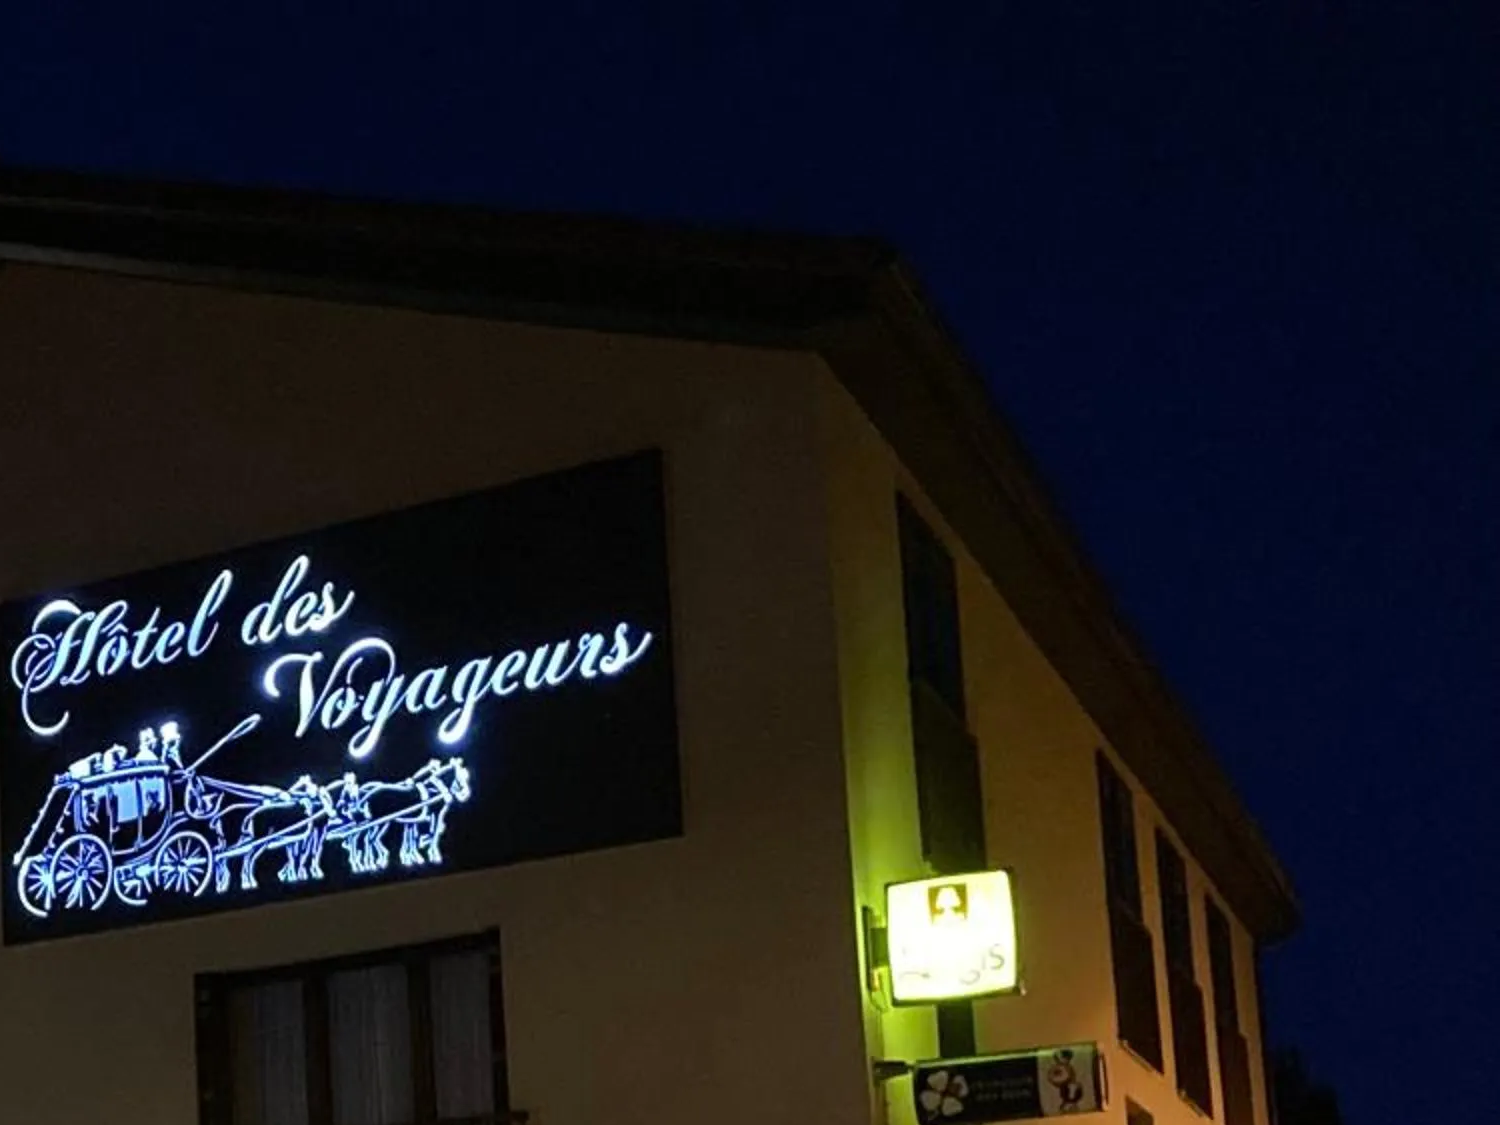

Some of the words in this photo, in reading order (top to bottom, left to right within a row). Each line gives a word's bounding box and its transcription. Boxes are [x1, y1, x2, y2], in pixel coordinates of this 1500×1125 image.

[11, 568, 233, 736] Hôtel
[241, 554, 355, 646] des
[263, 620, 653, 760] Voyageurs
